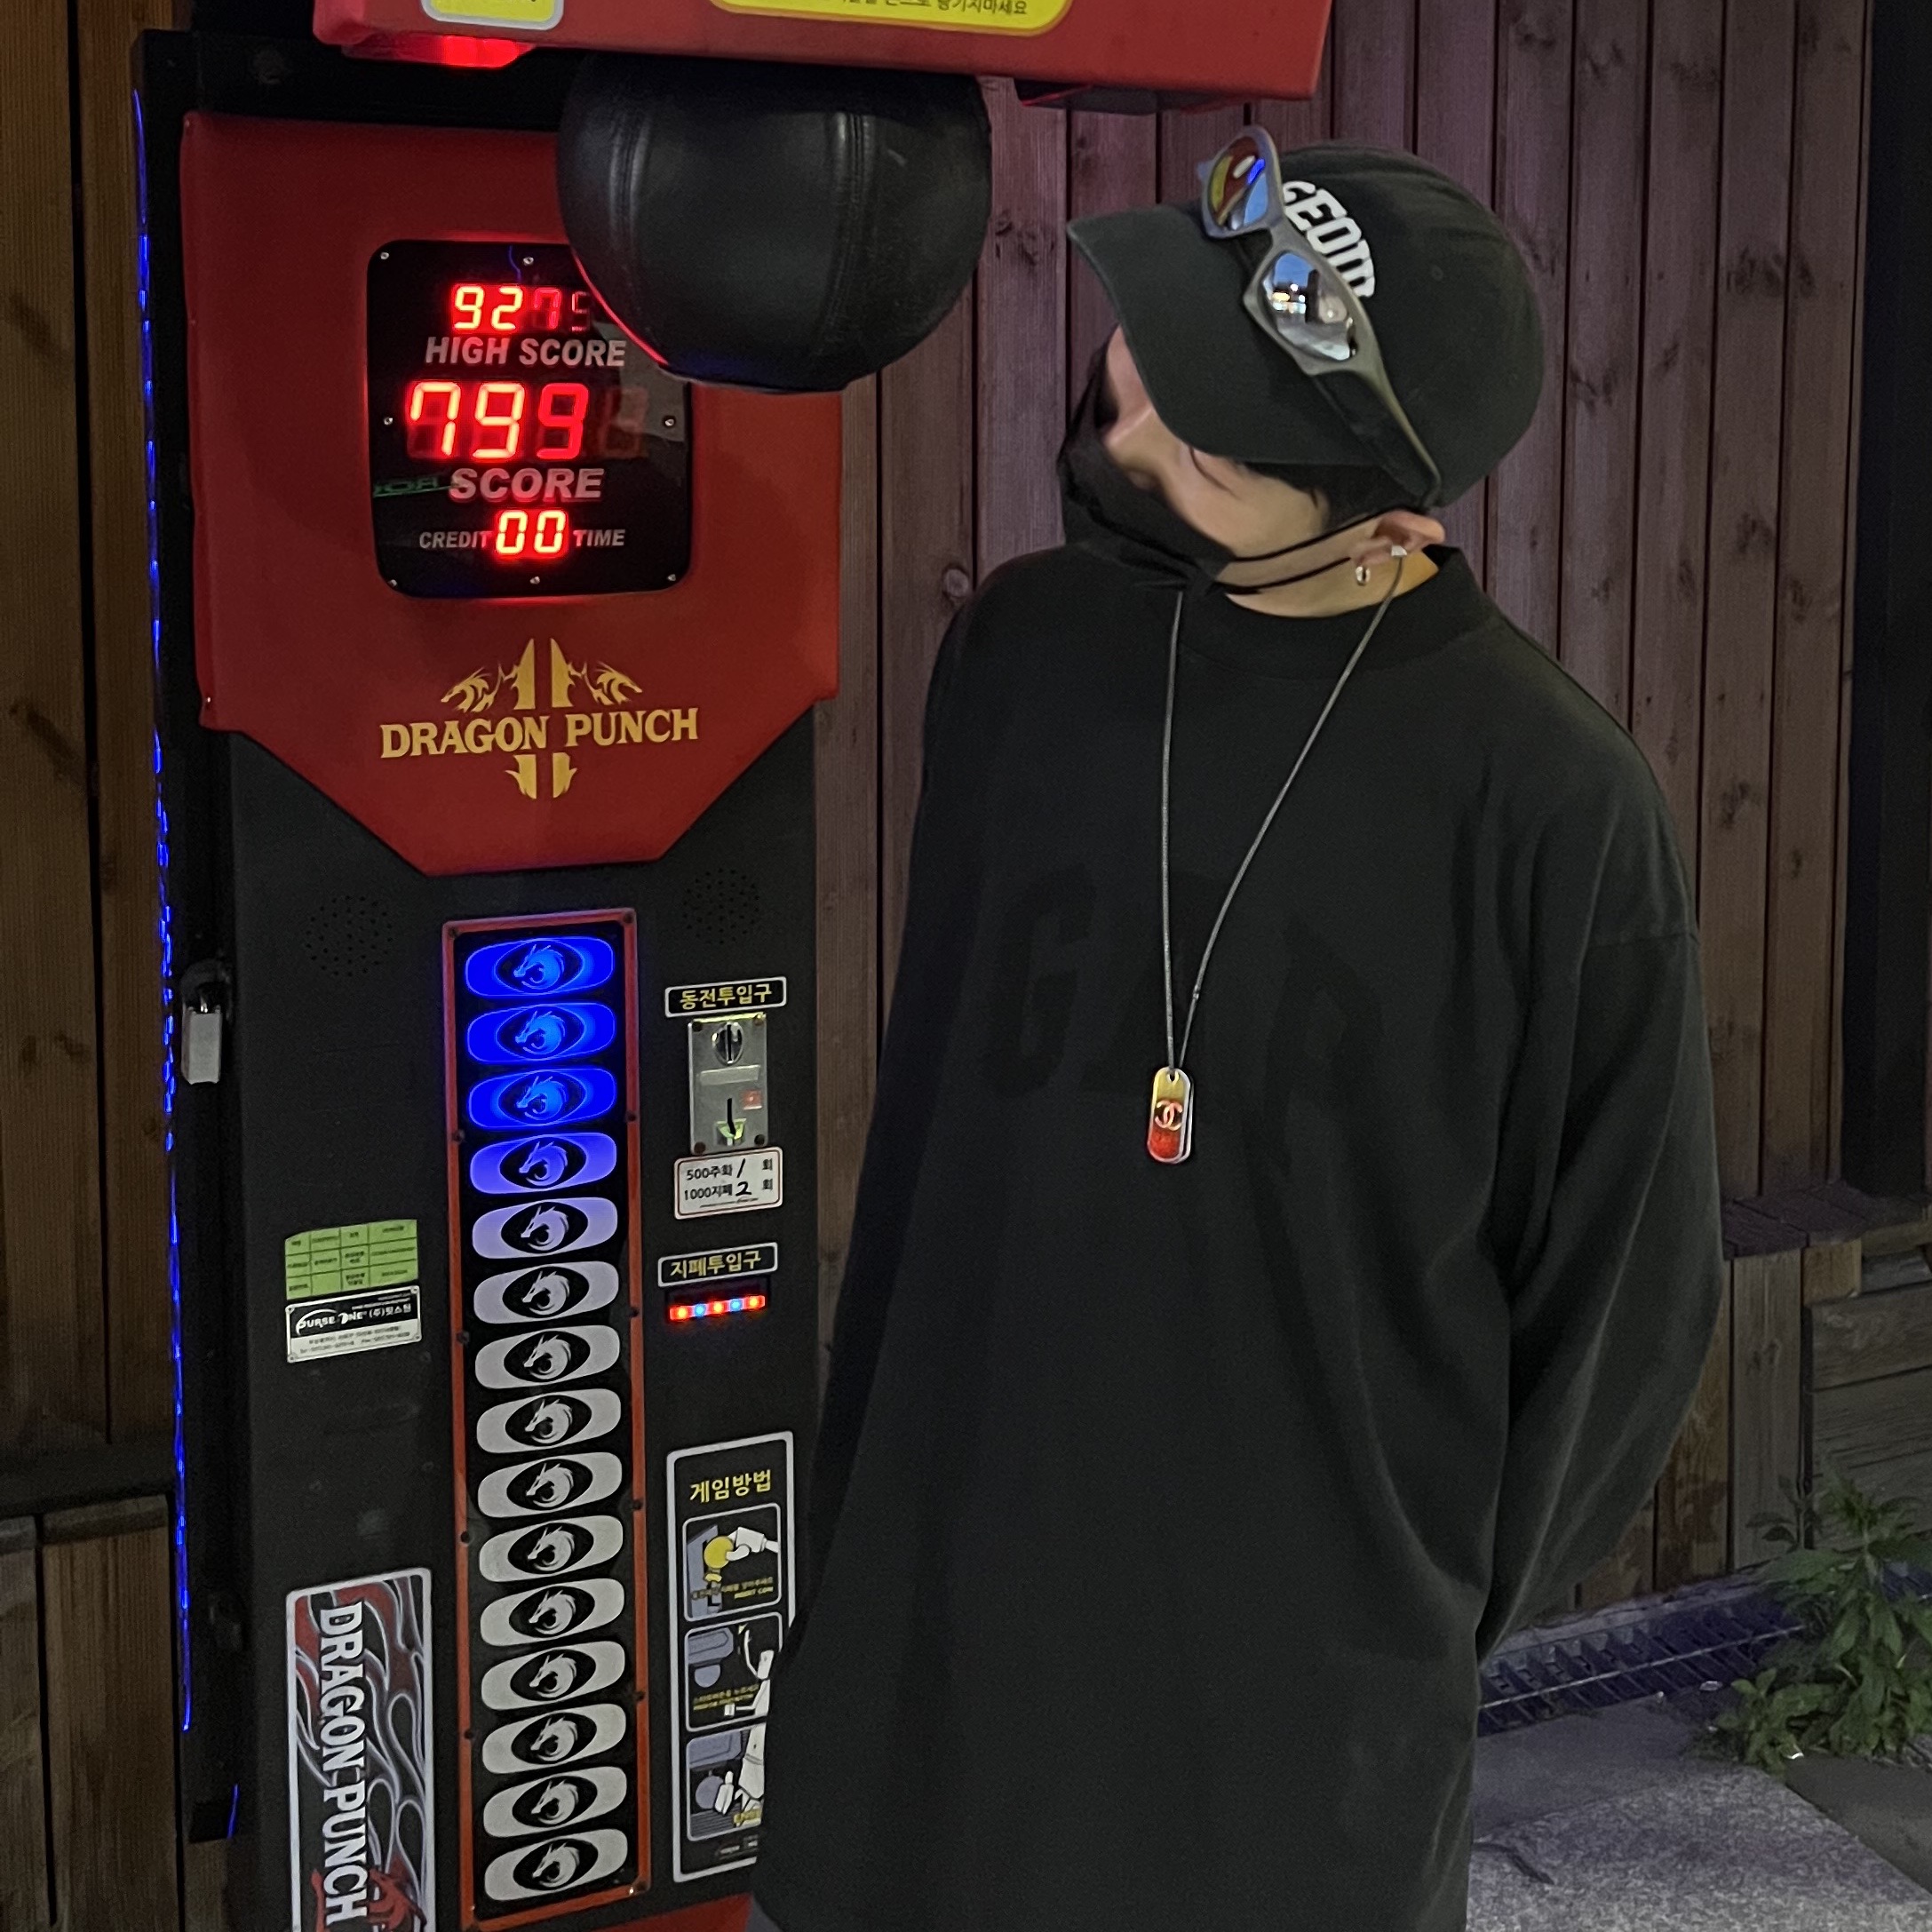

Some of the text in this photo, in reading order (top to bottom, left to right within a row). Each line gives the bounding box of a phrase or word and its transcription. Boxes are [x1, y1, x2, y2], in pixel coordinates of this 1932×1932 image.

[425, 337, 626, 367] HIGH SCORE
[409, 380, 589, 460] 799
[449, 468, 605, 502] SCORE
[419, 509, 625, 555] CREDIT 00 TIME
[379, 708, 698, 758] DRAGON PUNCH
[680, 983, 773, 1010] 동전투입구
[735, 1181, 752, 1197] 2
[670, 1250, 761, 1278] 지폐투입구
[689, 1469, 772, 1503] 게임방법
[320, 1601, 369, 1926] DRAGON PUNCH
